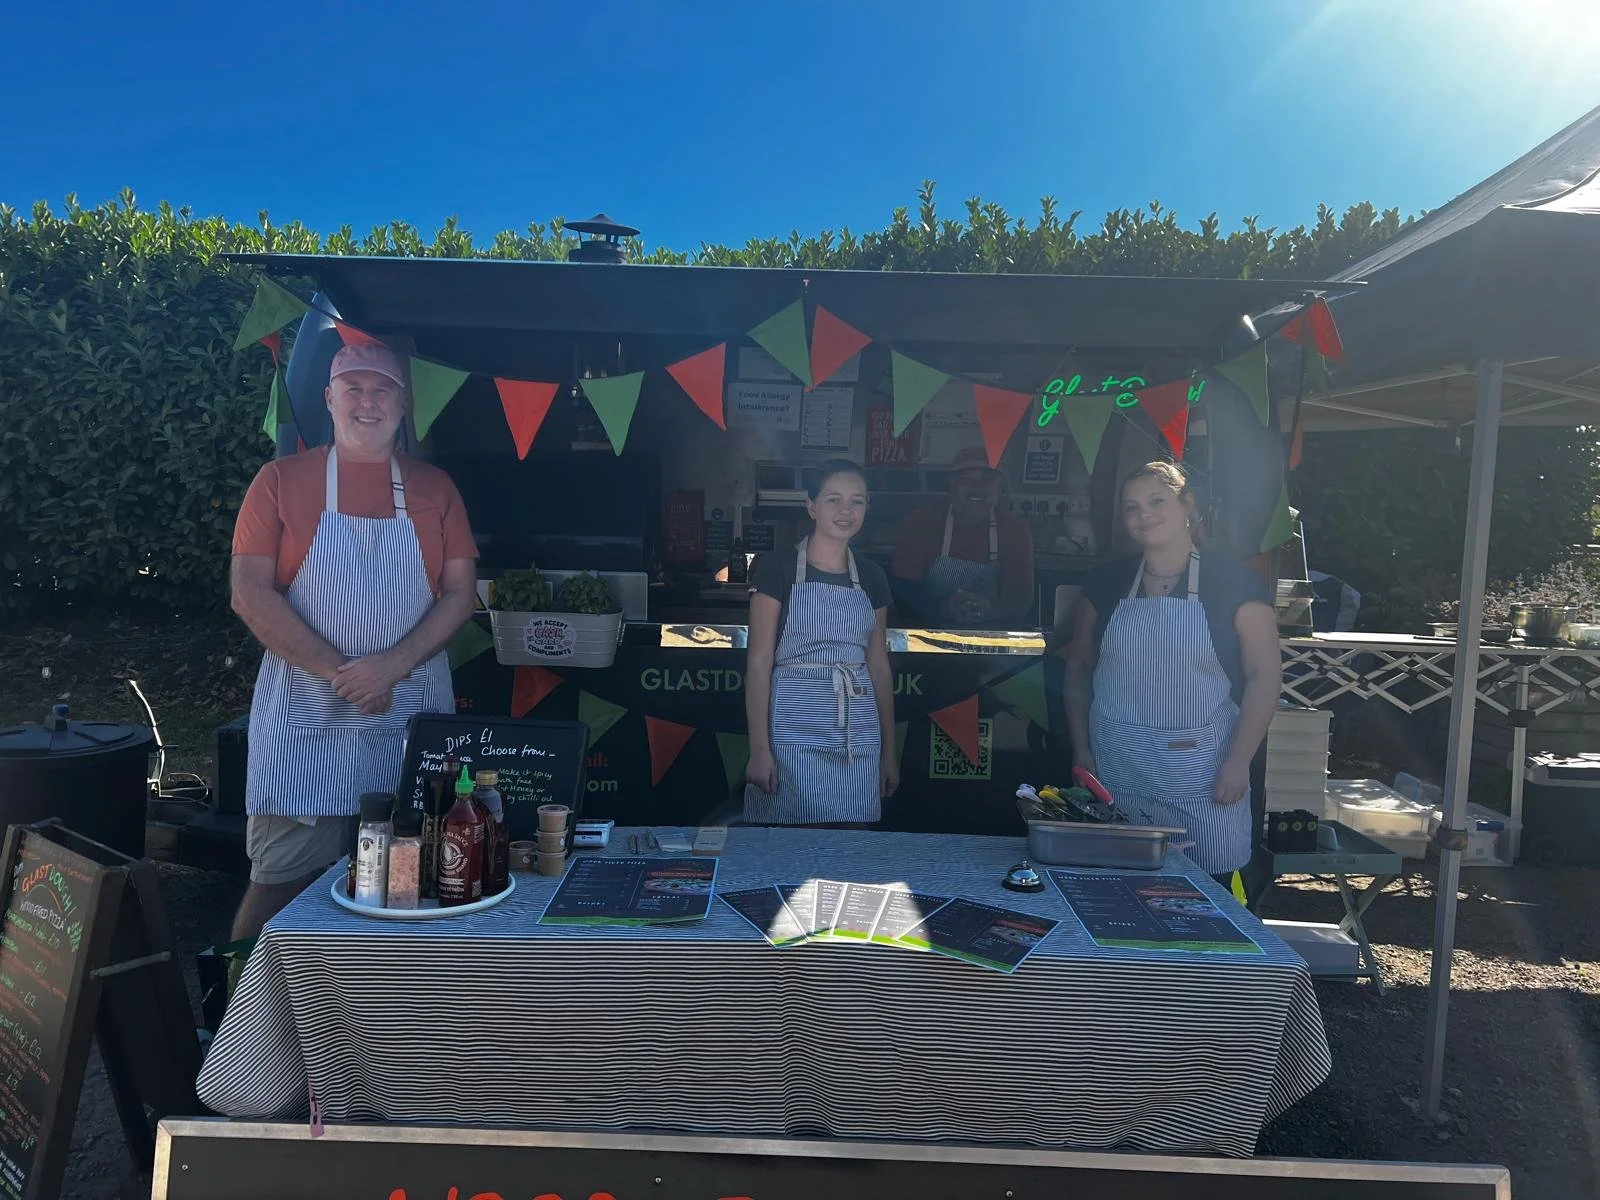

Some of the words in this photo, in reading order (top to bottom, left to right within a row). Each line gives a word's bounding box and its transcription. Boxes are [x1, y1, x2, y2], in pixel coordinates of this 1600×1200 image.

[761, 392, 791, 401] Allergy
[738, 402, 790, 412] Intolerance?
[871, 446, 906, 463] PIZZA
[544, 619, 568, 630] ACCEPT
[528, 644, 571, 656] COMPLIMENTS
[639, 668, 744, 692] GLASTD
[445, 733, 472, 753] DIPS
[479, 728, 493, 743] £1
[420, 750, 445, 761] Tomat
[481, 745, 517, 757] Choose
[418, 761, 444, 774] May
[586, 778, 619, 793] om
